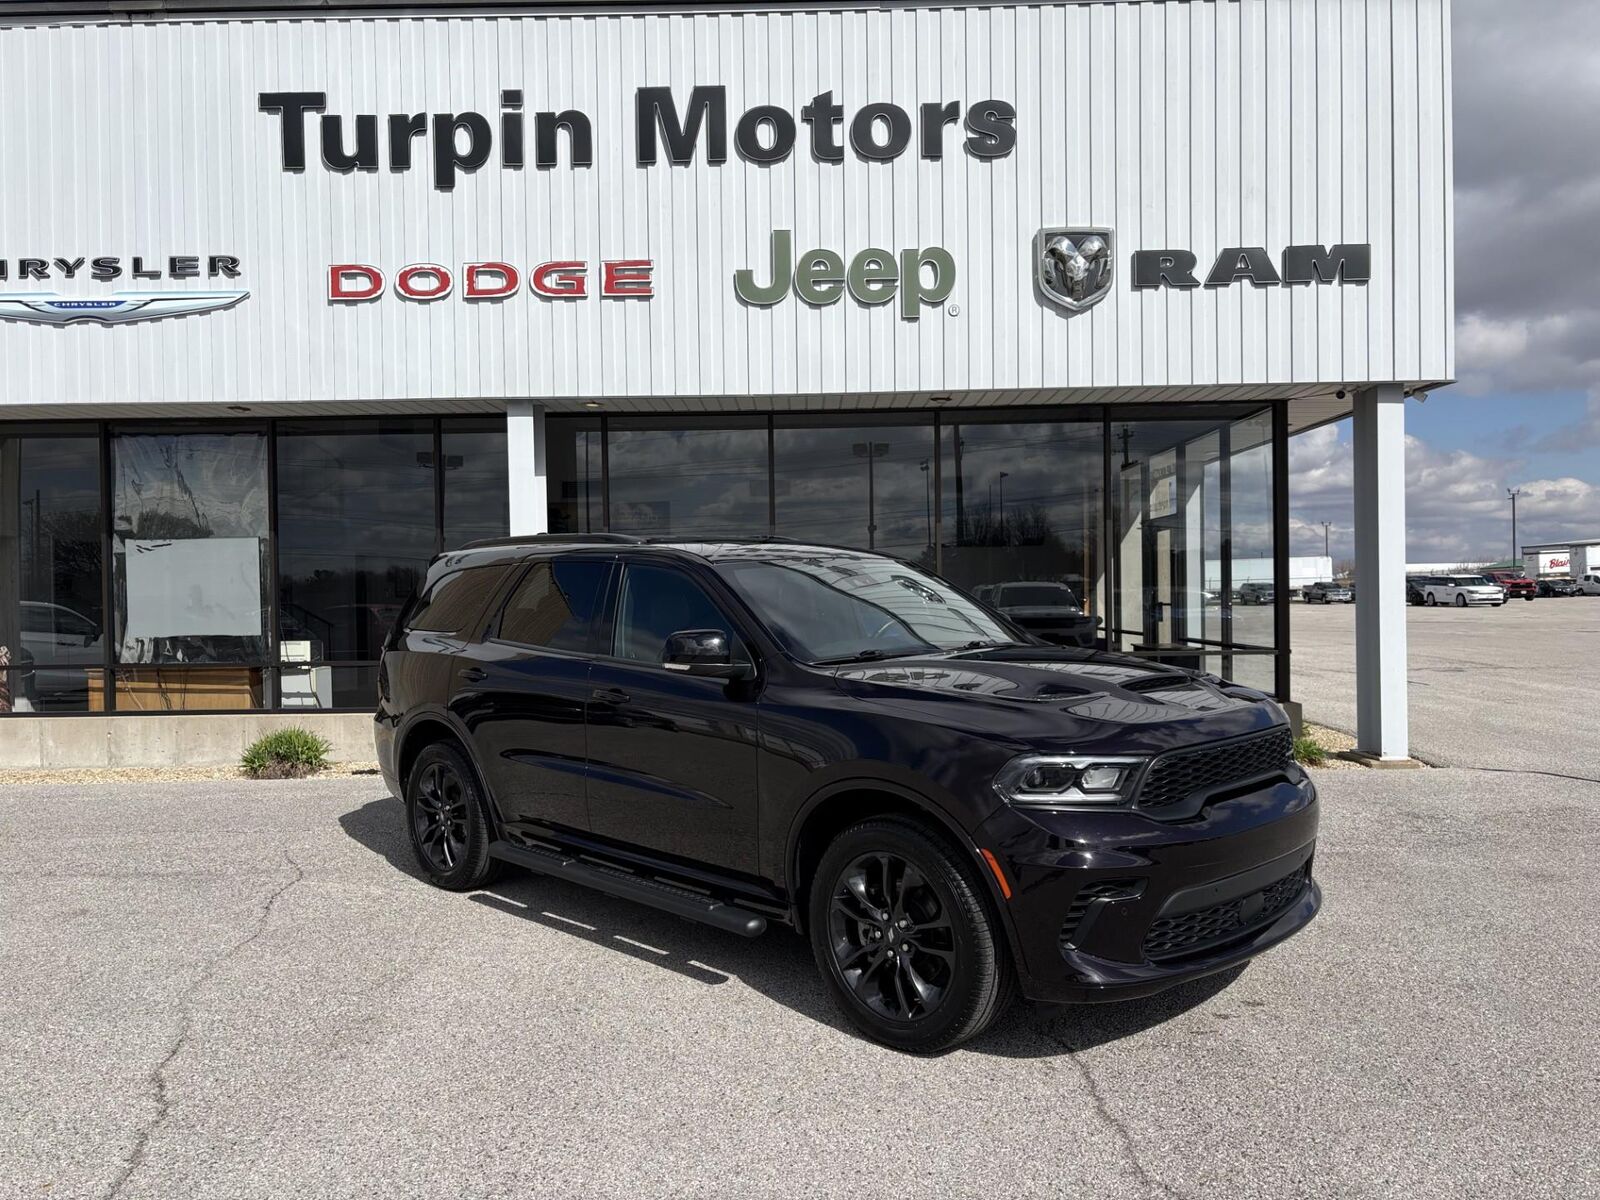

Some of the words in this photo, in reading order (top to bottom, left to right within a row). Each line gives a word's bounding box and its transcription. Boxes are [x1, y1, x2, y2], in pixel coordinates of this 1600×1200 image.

[258, 89, 593, 189] Turpin
[636, 85, 1017, 164] Motors
[328, 259, 654, 302] DODGE
[734, 229, 956, 320] Jeep
[1132, 243, 1372, 287] RAM
